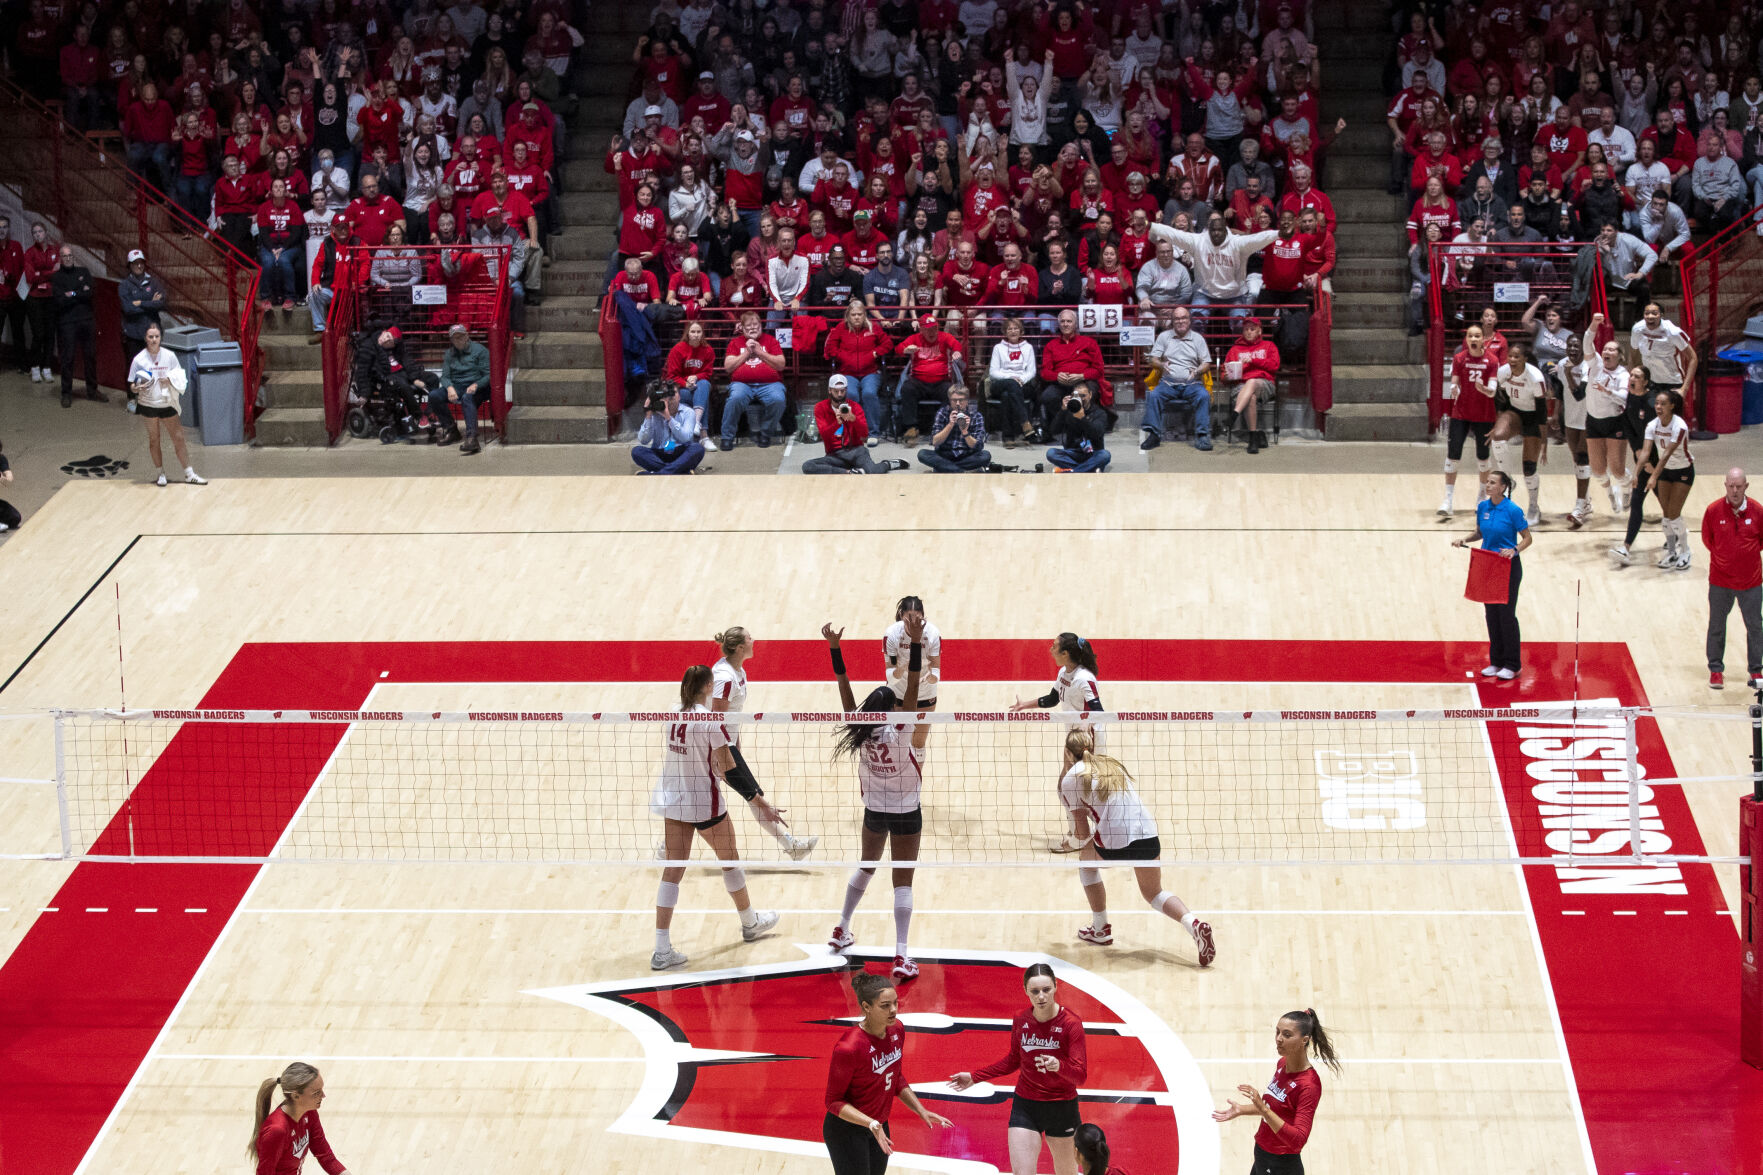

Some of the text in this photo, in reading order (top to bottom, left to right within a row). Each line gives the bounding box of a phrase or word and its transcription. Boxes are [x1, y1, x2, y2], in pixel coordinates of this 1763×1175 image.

[1082, 308, 1119, 328] B B
[1008, 350, 1022, 362] W
[153, 710, 201, 719] WISCONSIN
[203, 710, 245, 720] BADGERS
[310, 711, 359, 720] WISCONSIN
[361, 711, 404, 721] BADGERS
[468, 712, 518, 721] WISCONSIN
[521, 712, 564, 721] BADGERS
[629, 712, 680, 721] WISCONSIN
[682, 712, 725, 722] BADGERS
[791, 712, 842, 722] WISCONSIN
[844, 712, 887, 722] BADGERS
[954, 712, 1005, 721] WISCONSIN
[1007, 712, 1051, 721] BADGERS
[1117, 711, 1168, 721] WISCONSIN
[1170, 711, 1214, 720] BADGERS
[1281, 711, 1332, 720] WISCONSIN
[1334, 710, 1377, 720] BADGERS
[1444, 709, 1494, 719] WISCONSIN
[1496, 708, 1540, 718] BADGERS
[670, 723, 688, 745] 14
[1510, 697, 1689, 896] WISCONSIN
[1021, 1032, 1060, 1048] Nebraska
[884, 1072, 894, 1091] 5
